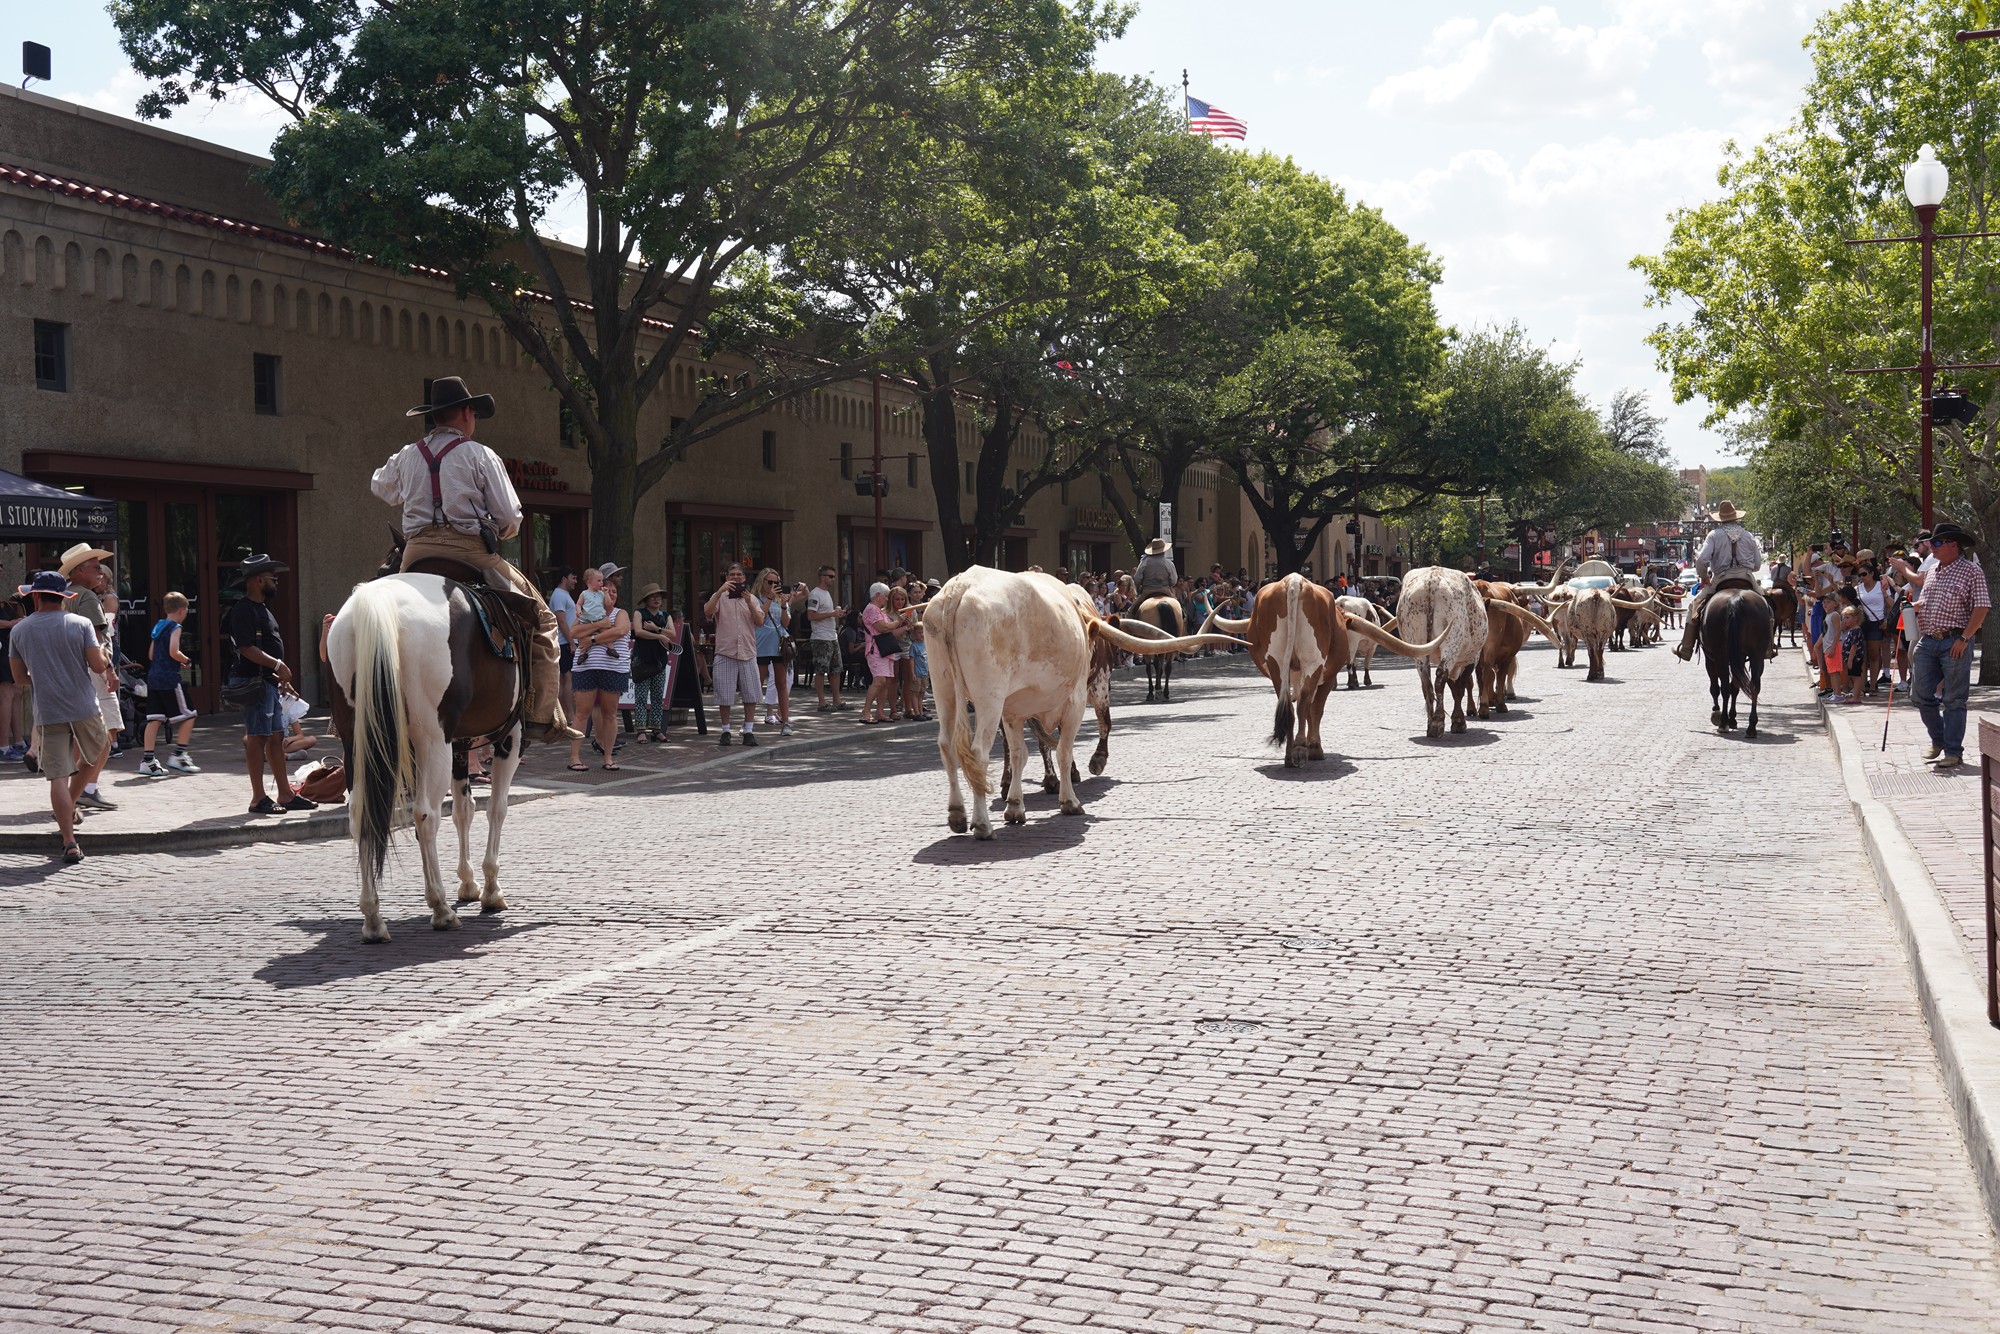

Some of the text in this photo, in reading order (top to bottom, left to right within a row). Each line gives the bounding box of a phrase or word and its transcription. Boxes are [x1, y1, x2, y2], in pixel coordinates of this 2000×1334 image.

[527, 461, 560, 475] coffee
[8, 505, 78, 529] STOCKYARDS
[88, 515, 108, 524] 1890
